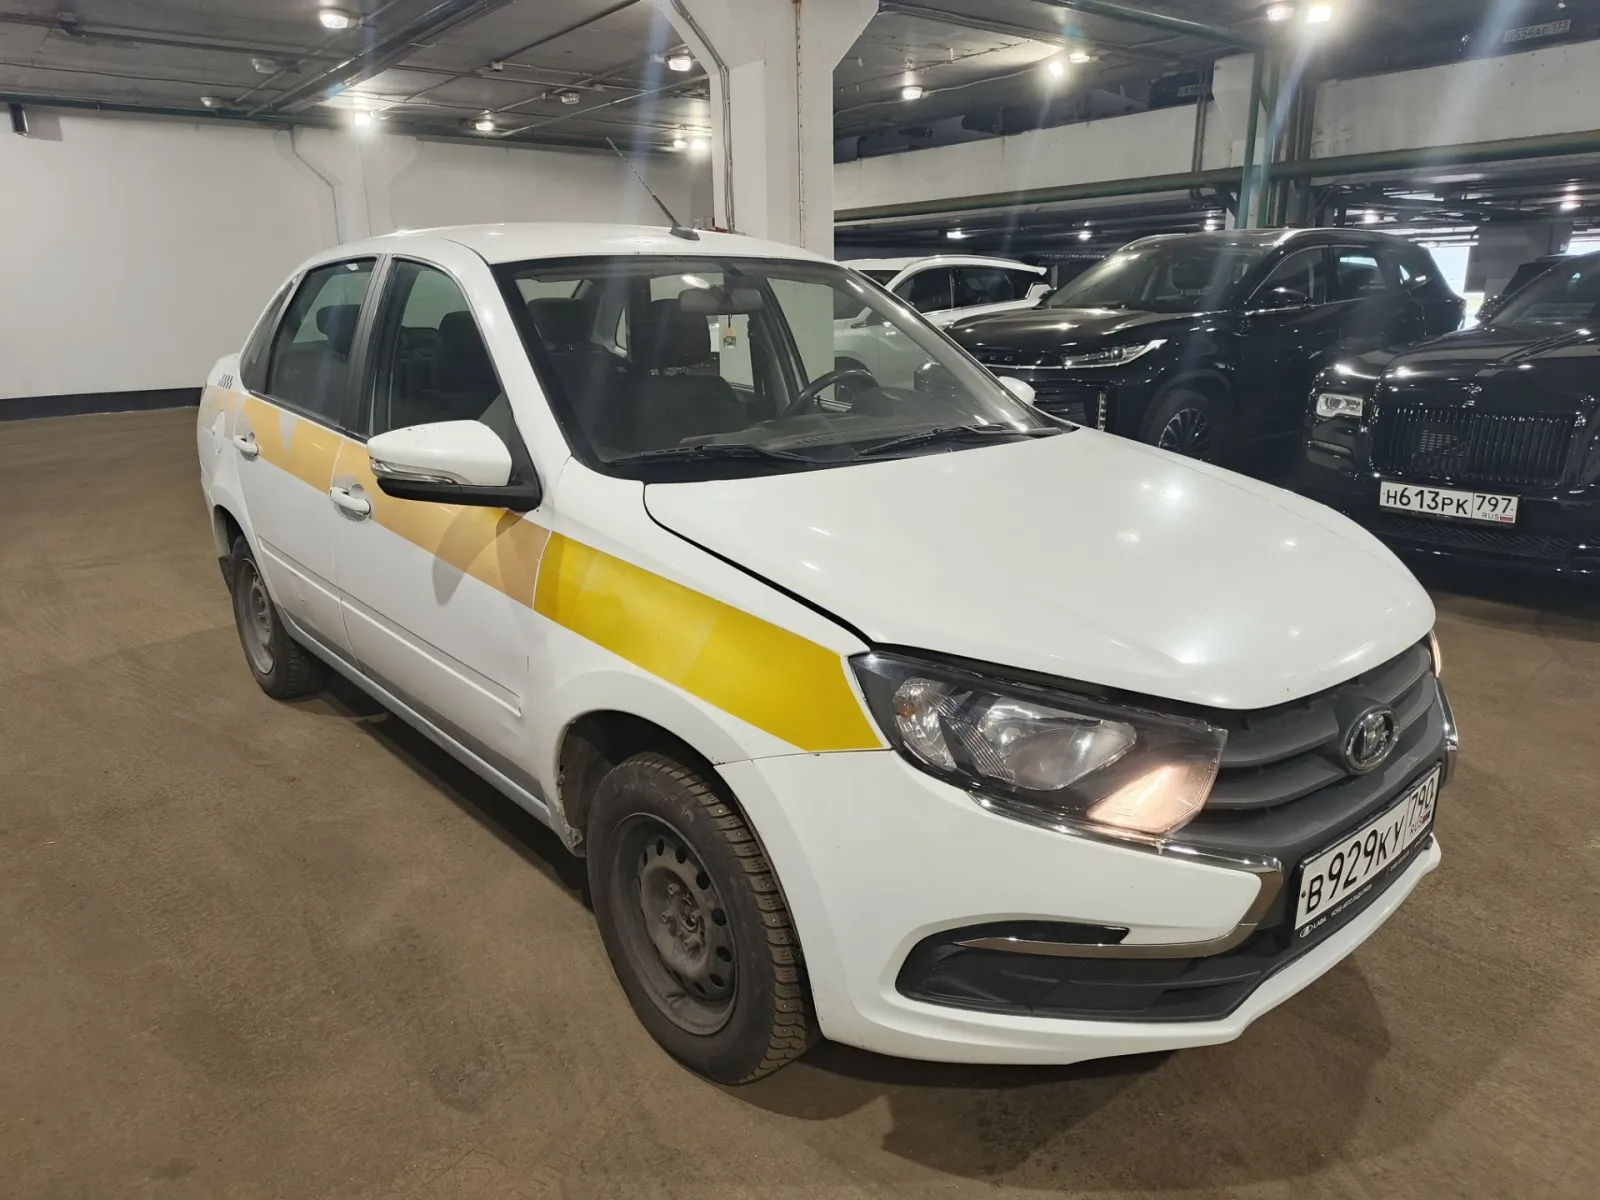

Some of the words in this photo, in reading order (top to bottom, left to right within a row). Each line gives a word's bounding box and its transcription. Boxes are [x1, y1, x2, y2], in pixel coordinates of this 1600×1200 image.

[1386, 487, 1469, 515] Н613РК
[1476, 495, 1513, 514] 797
[1481, 512, 1500, 521] RUS
[1305, 814, 1405, 916] В929КУ
[1409, 777, 1435, 828] 790
